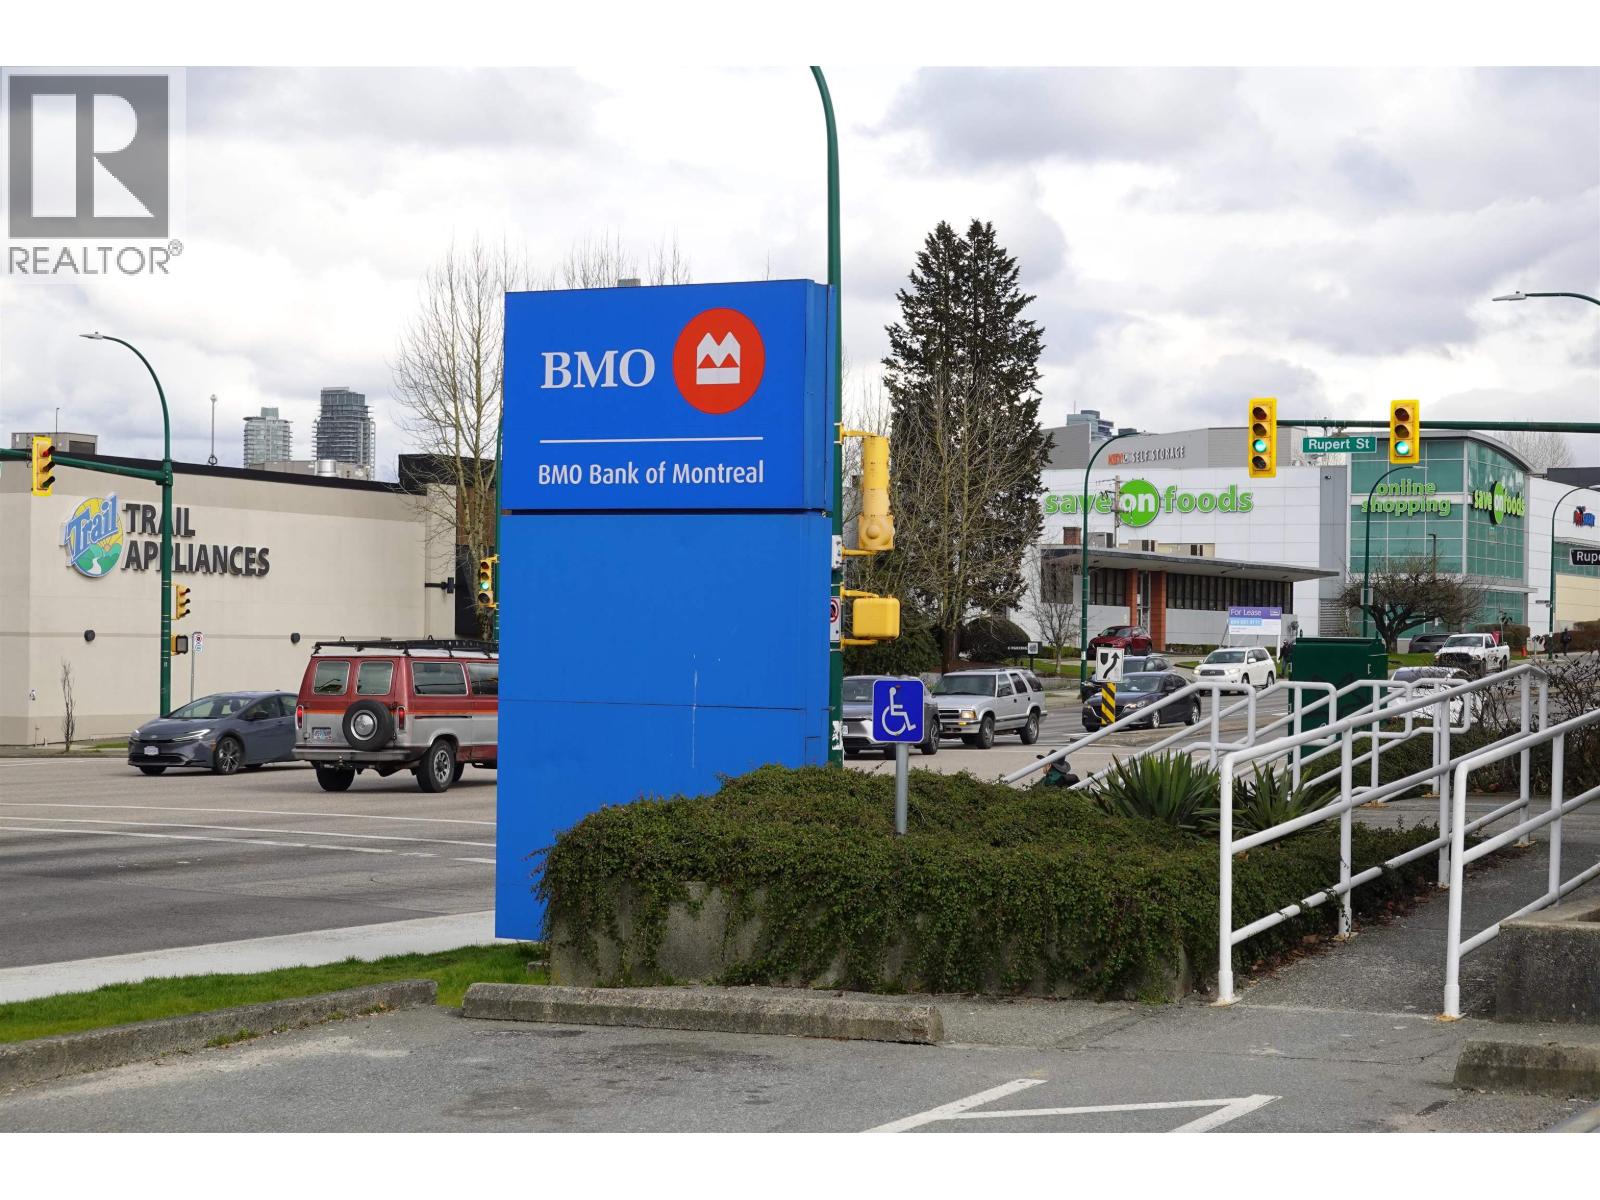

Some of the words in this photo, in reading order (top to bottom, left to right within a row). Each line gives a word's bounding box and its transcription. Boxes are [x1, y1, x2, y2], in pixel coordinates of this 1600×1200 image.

[540, 349, 655, 388] BMO
[1152, 446, 1185, 461] STORAGE
[1308, 438, 1350, 451] Rupert
[1356, 438, 1370, 449] St
[538, 464, 582, 484] BMO
[589, 461, 639, 484] Bank
[646, 460, 666, 484] of
[672, 459, 764, 484] Montreal
[1376, 478, 1437, 496] online
[1045, 492, 1113, 514] save
[1118, 493, 1155, 513] on
[1163, 484, 1255, 514] foods
[1361, 496, 1451, 517] shopping
[1474, 489, 1493, 511] save
[1503, 487, 1526, 517] foods
[64, 494, 118, 560] Trail
[122, 540, 270, 577] APLIANCES
[1576, 551, 1600, 564] Rup
[1230, 608, 1241, 616] For
